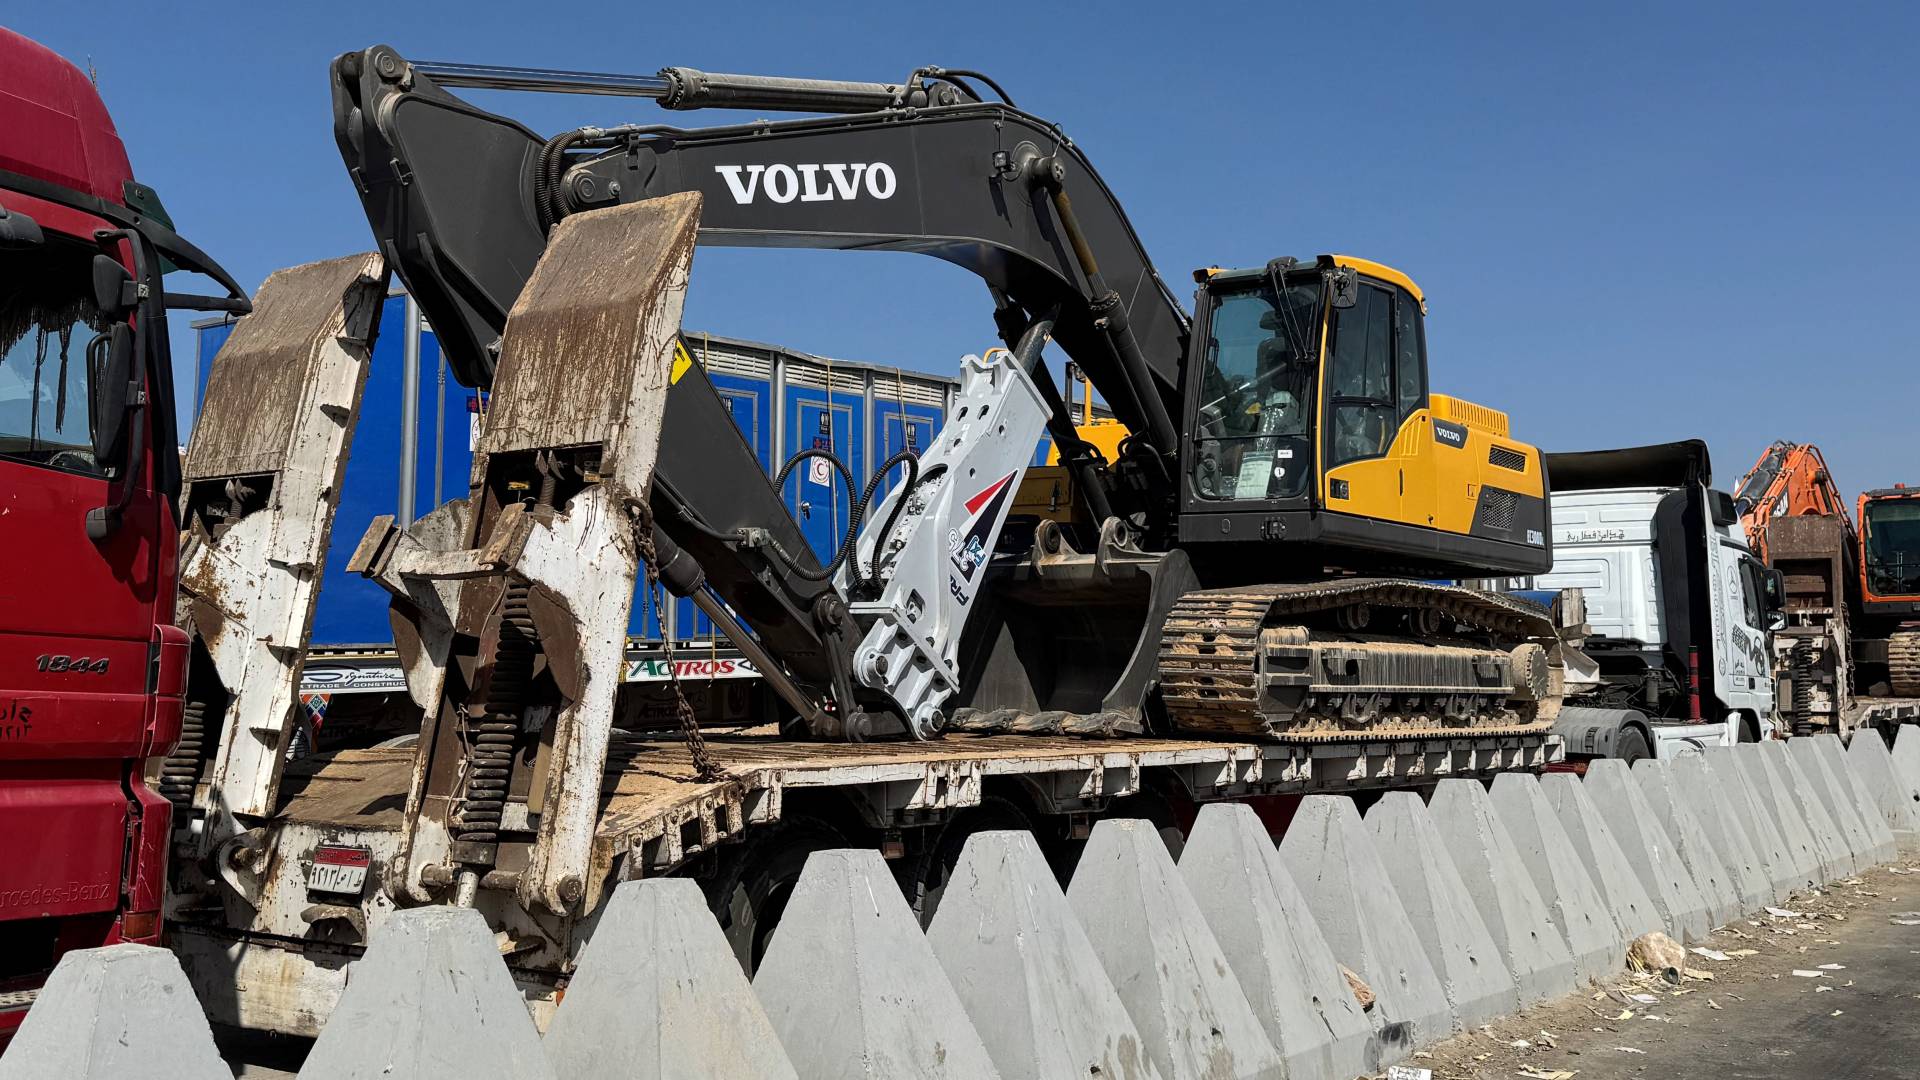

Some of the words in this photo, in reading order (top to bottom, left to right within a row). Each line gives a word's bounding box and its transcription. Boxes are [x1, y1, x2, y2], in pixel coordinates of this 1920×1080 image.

[715, 162, 897, 204] VOLVO
[1436, 427, 1461, 442] VOLVO
[36, 654, 110, 674] 1844
